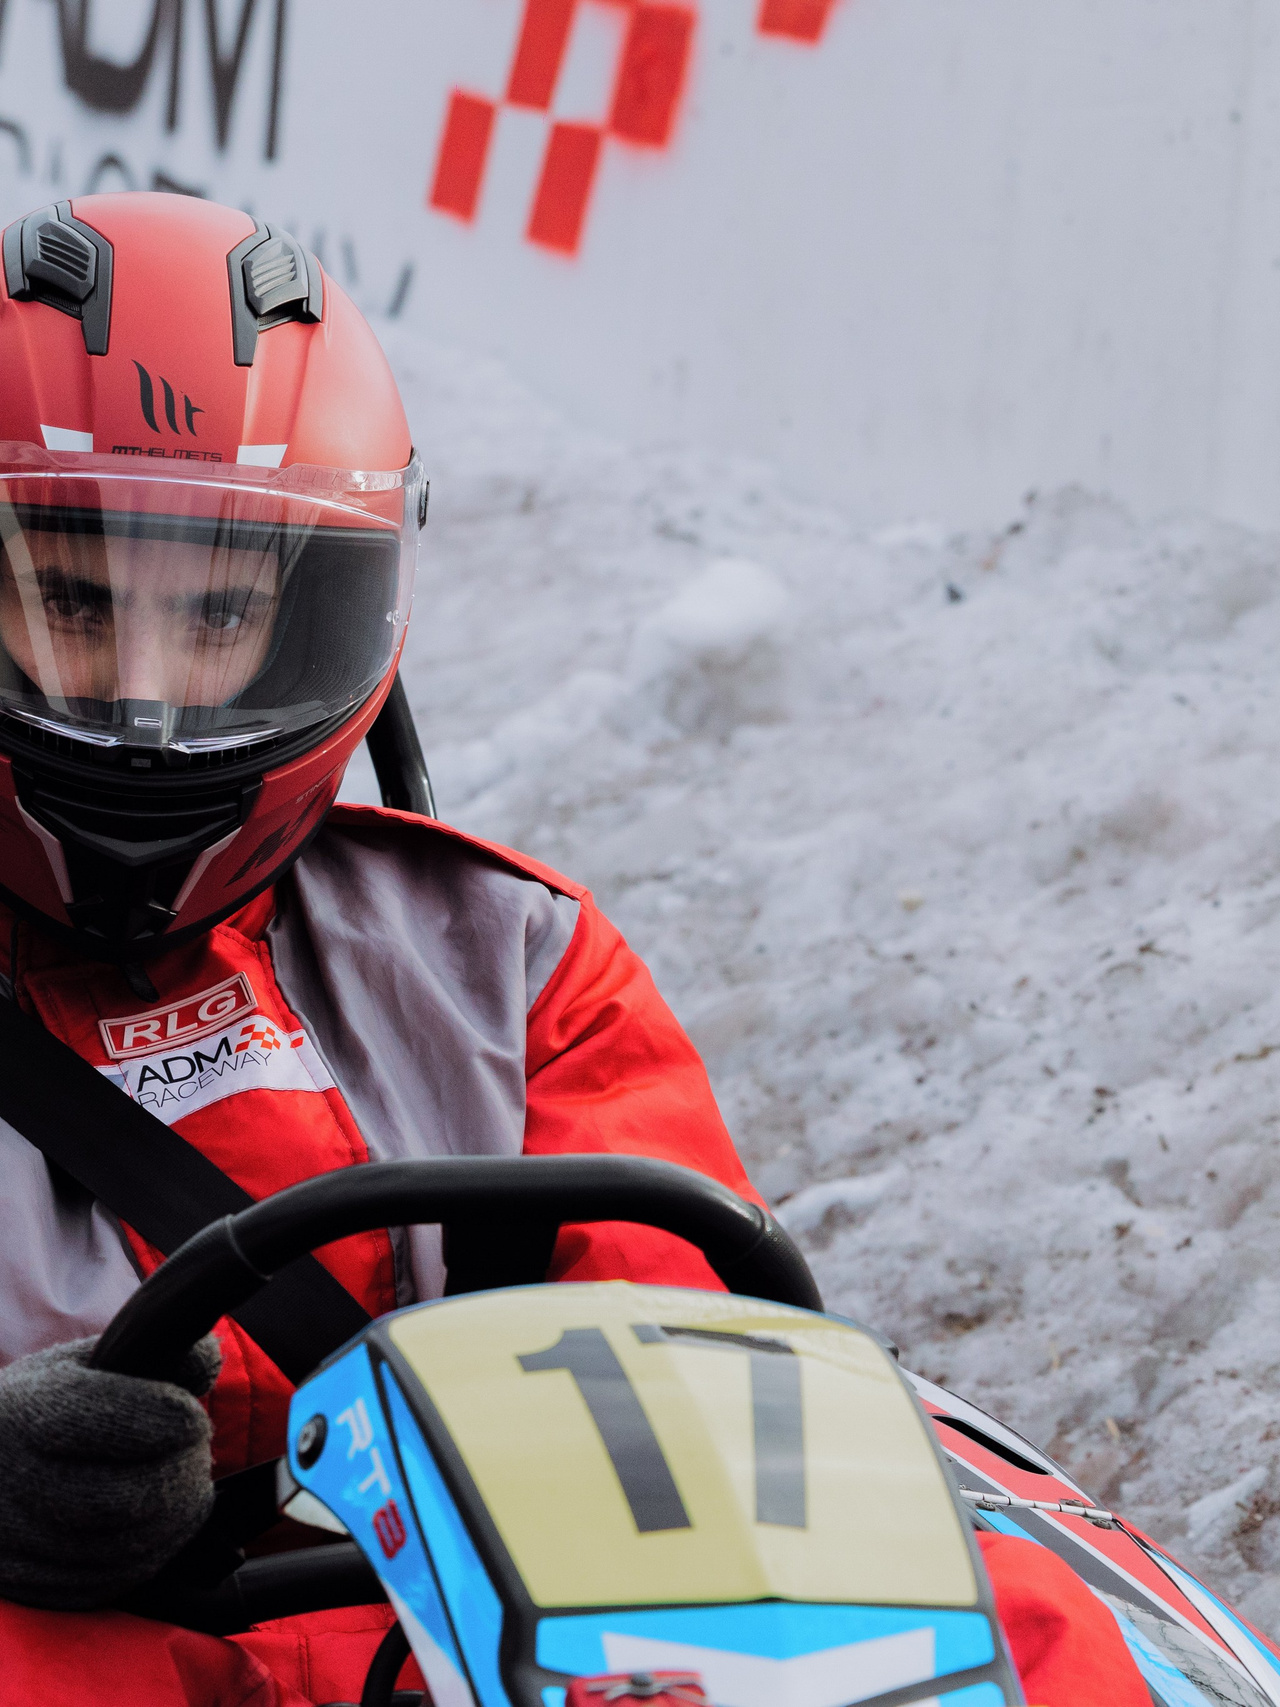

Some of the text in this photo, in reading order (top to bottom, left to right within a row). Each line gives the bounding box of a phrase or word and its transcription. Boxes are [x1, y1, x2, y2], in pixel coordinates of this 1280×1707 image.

[122, 990, 237, 1049] RLG
[136, 1036, 233, 1093] ADM
[136, 1051, 272, 1109] RACEWAY
[516, 1324, 808, 1534] 17
